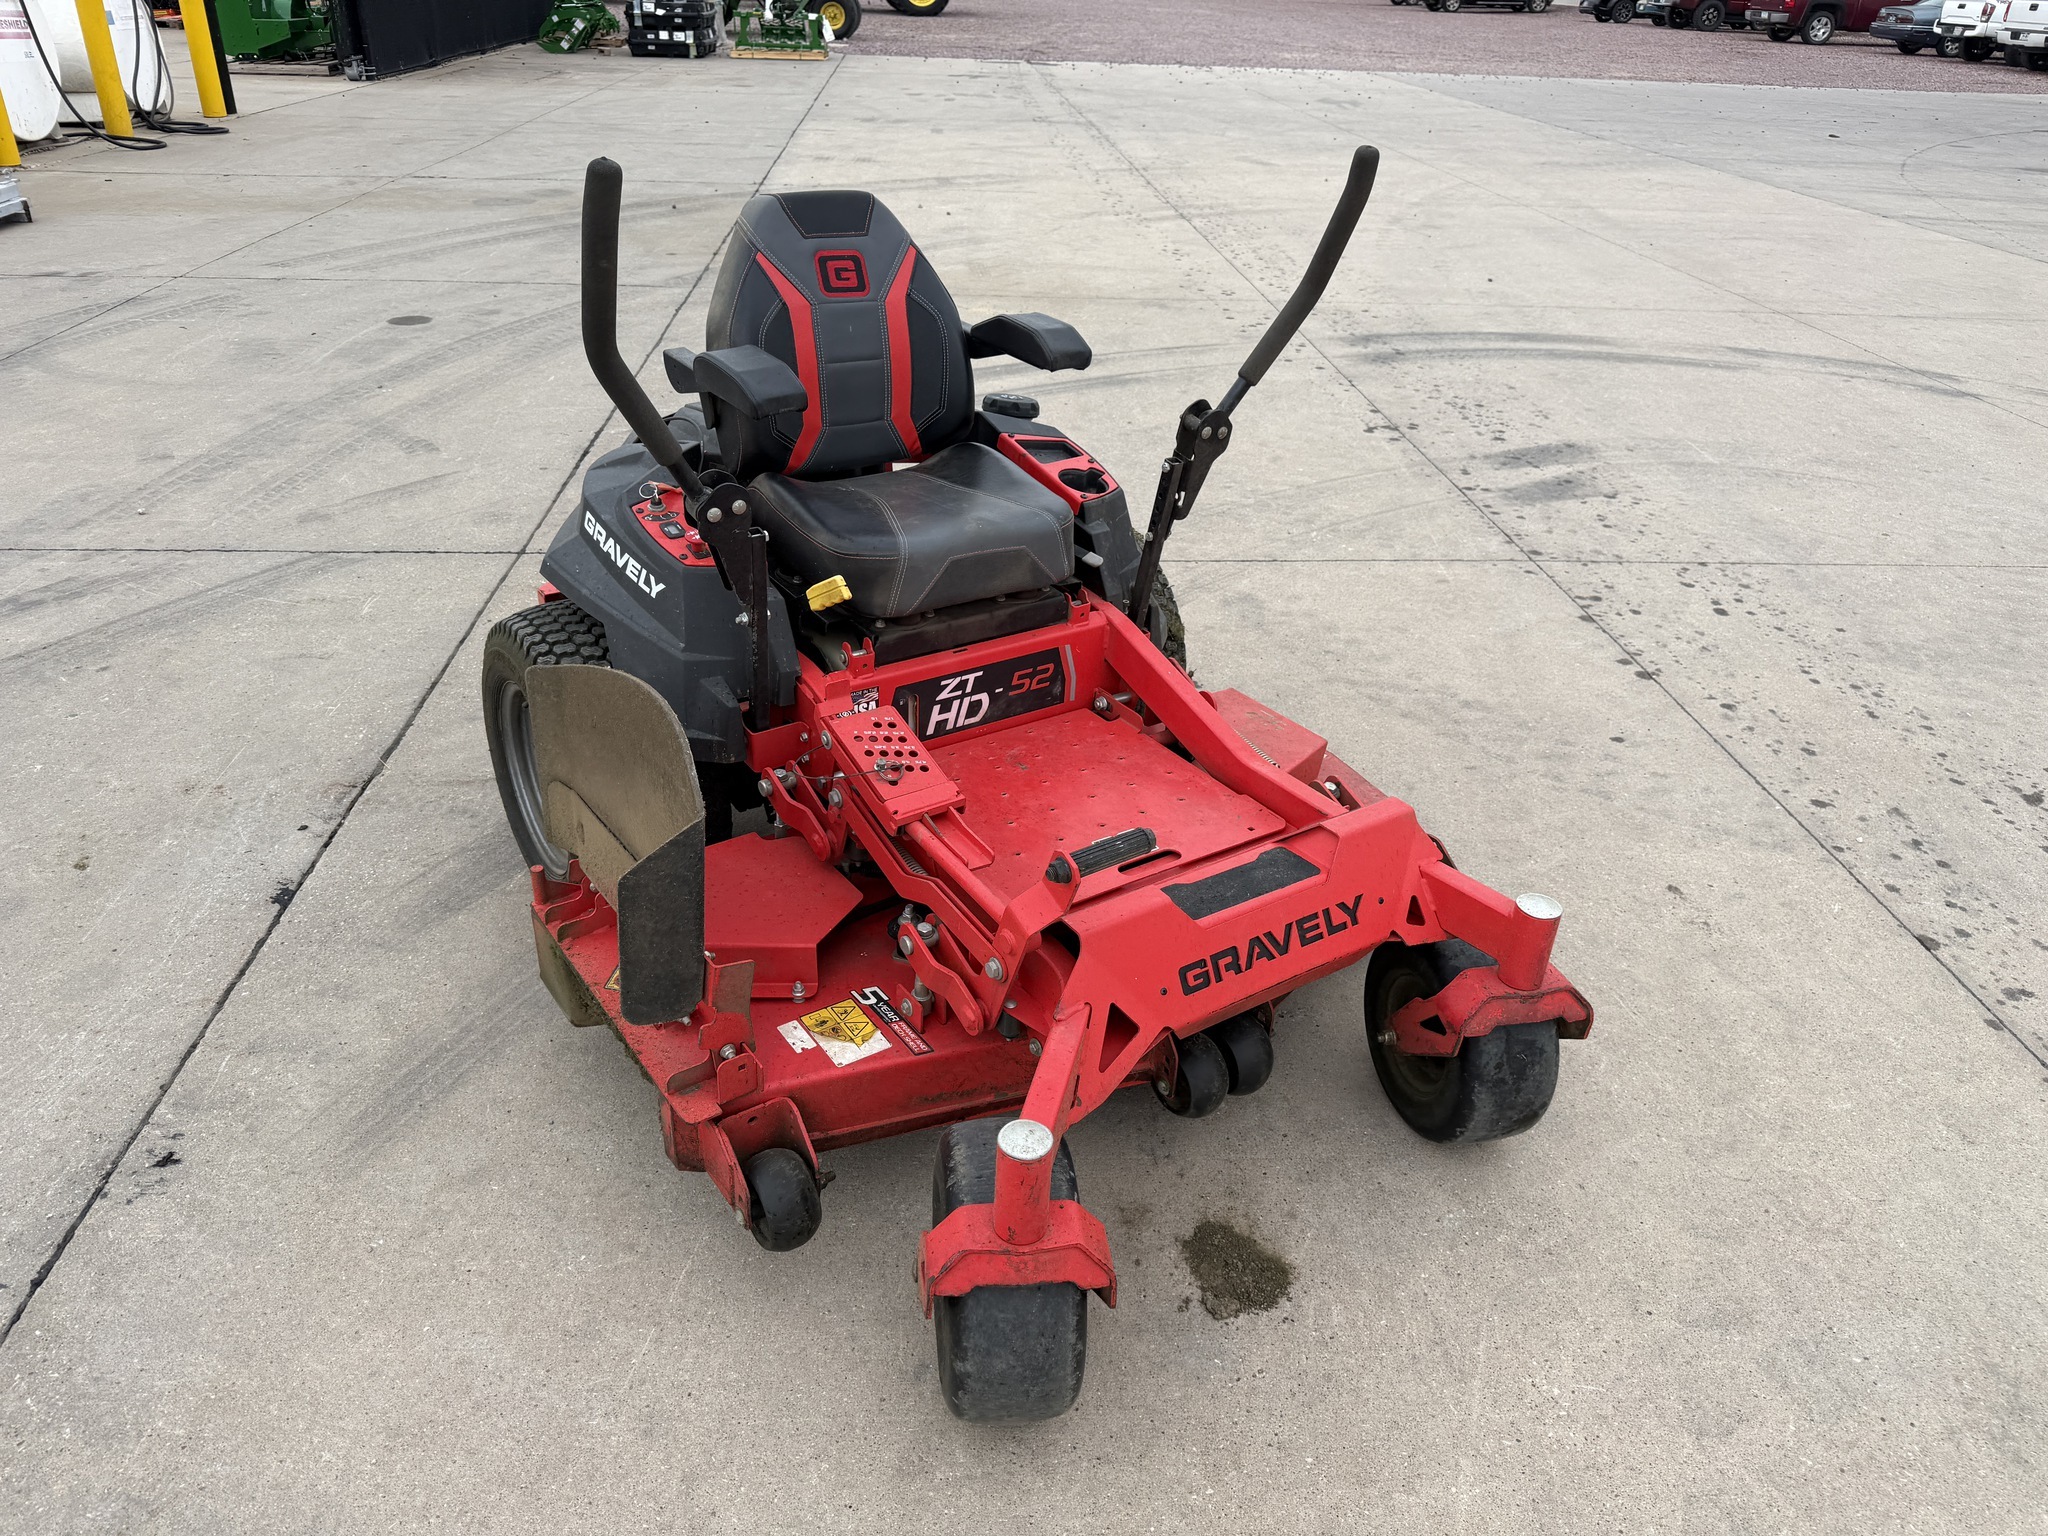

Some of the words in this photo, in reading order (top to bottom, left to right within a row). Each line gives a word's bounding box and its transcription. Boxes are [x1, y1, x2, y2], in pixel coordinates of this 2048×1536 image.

[826, 260, 858, 288] G
[584, 510, 666, 599] GRAVELY
[935, 671, 984, 701] ZT
[926, 692, 990, 736] HD
[1178, 893, 1364, 996] GRAVELY
[851, 986, 890, 1005] 5
[877, 1001, 900, 1022] YEAR
[915, 1038, 929, 1052] AND
